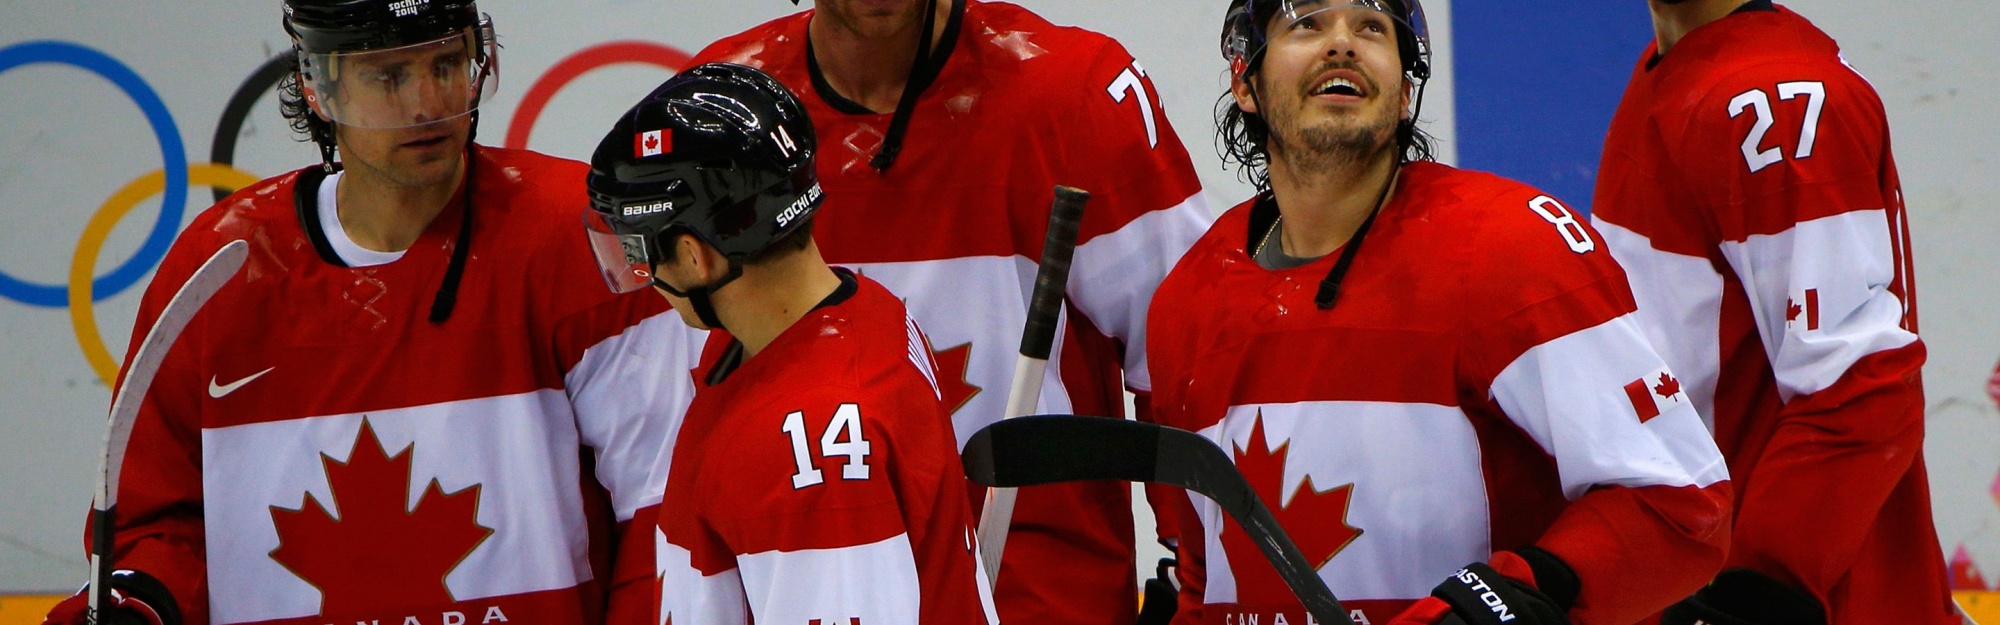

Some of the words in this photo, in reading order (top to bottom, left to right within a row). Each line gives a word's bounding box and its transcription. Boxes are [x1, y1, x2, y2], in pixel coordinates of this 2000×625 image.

[395, 6, 418, 17] 2014
[1105, 58, 1165, 150] 7
[1727, 81, 1826, 173] 27
[770, 124, 797, 158] 14
[623, 201, 673, 216] BAUER
[776, 194, 810, 227] SOCHI
[1528, 194, 1595, 254] 8
[781, 402, 871, 490] 14
[1449, 568, 1516, 622] ASTON
